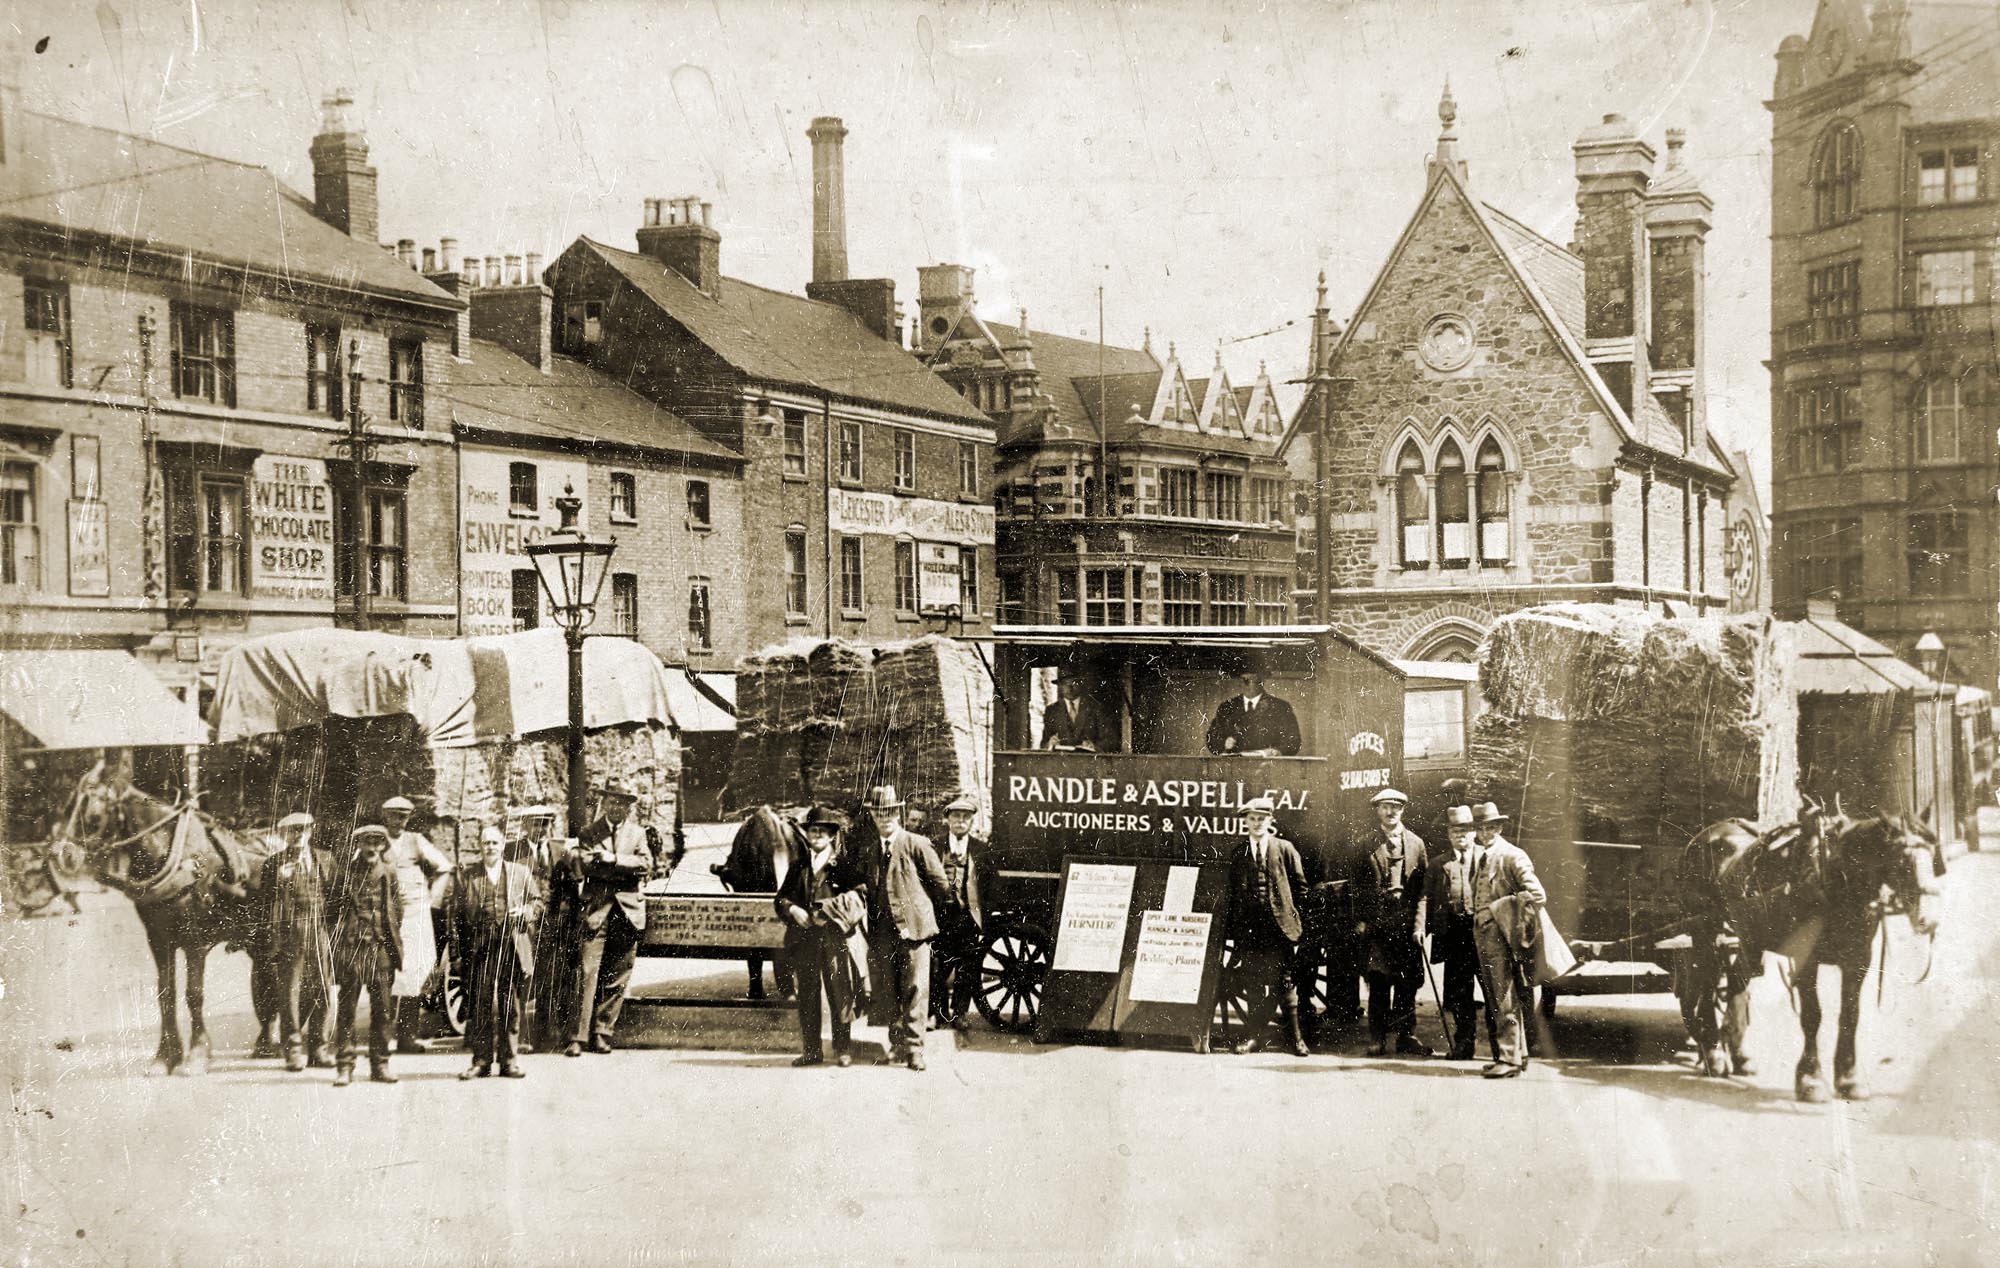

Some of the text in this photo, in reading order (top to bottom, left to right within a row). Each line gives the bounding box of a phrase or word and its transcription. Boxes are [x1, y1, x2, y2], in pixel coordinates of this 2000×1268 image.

[273, 463, 309, 481] THE
[254, 481, 326, 514] WHITE
[252, 516, 332, 543] CHOCOLATE
[463, 570, 511, 590] PRINTERS
[467, 597, 506, 616] BOOK
[1350, 732, 1385, 755] OFFICES
[1009, 776, 1117, 805] RANDLE
[1123, 784, 1138, 803] &
[1141, 780, 1247, 809] ASPELL
[1025, 811, 1284, 837] AUCTIONEERS & VALUES.
[1068, 920, 1117, 930] FURNITURE
[1175, 954, 1201, 966] Plants
